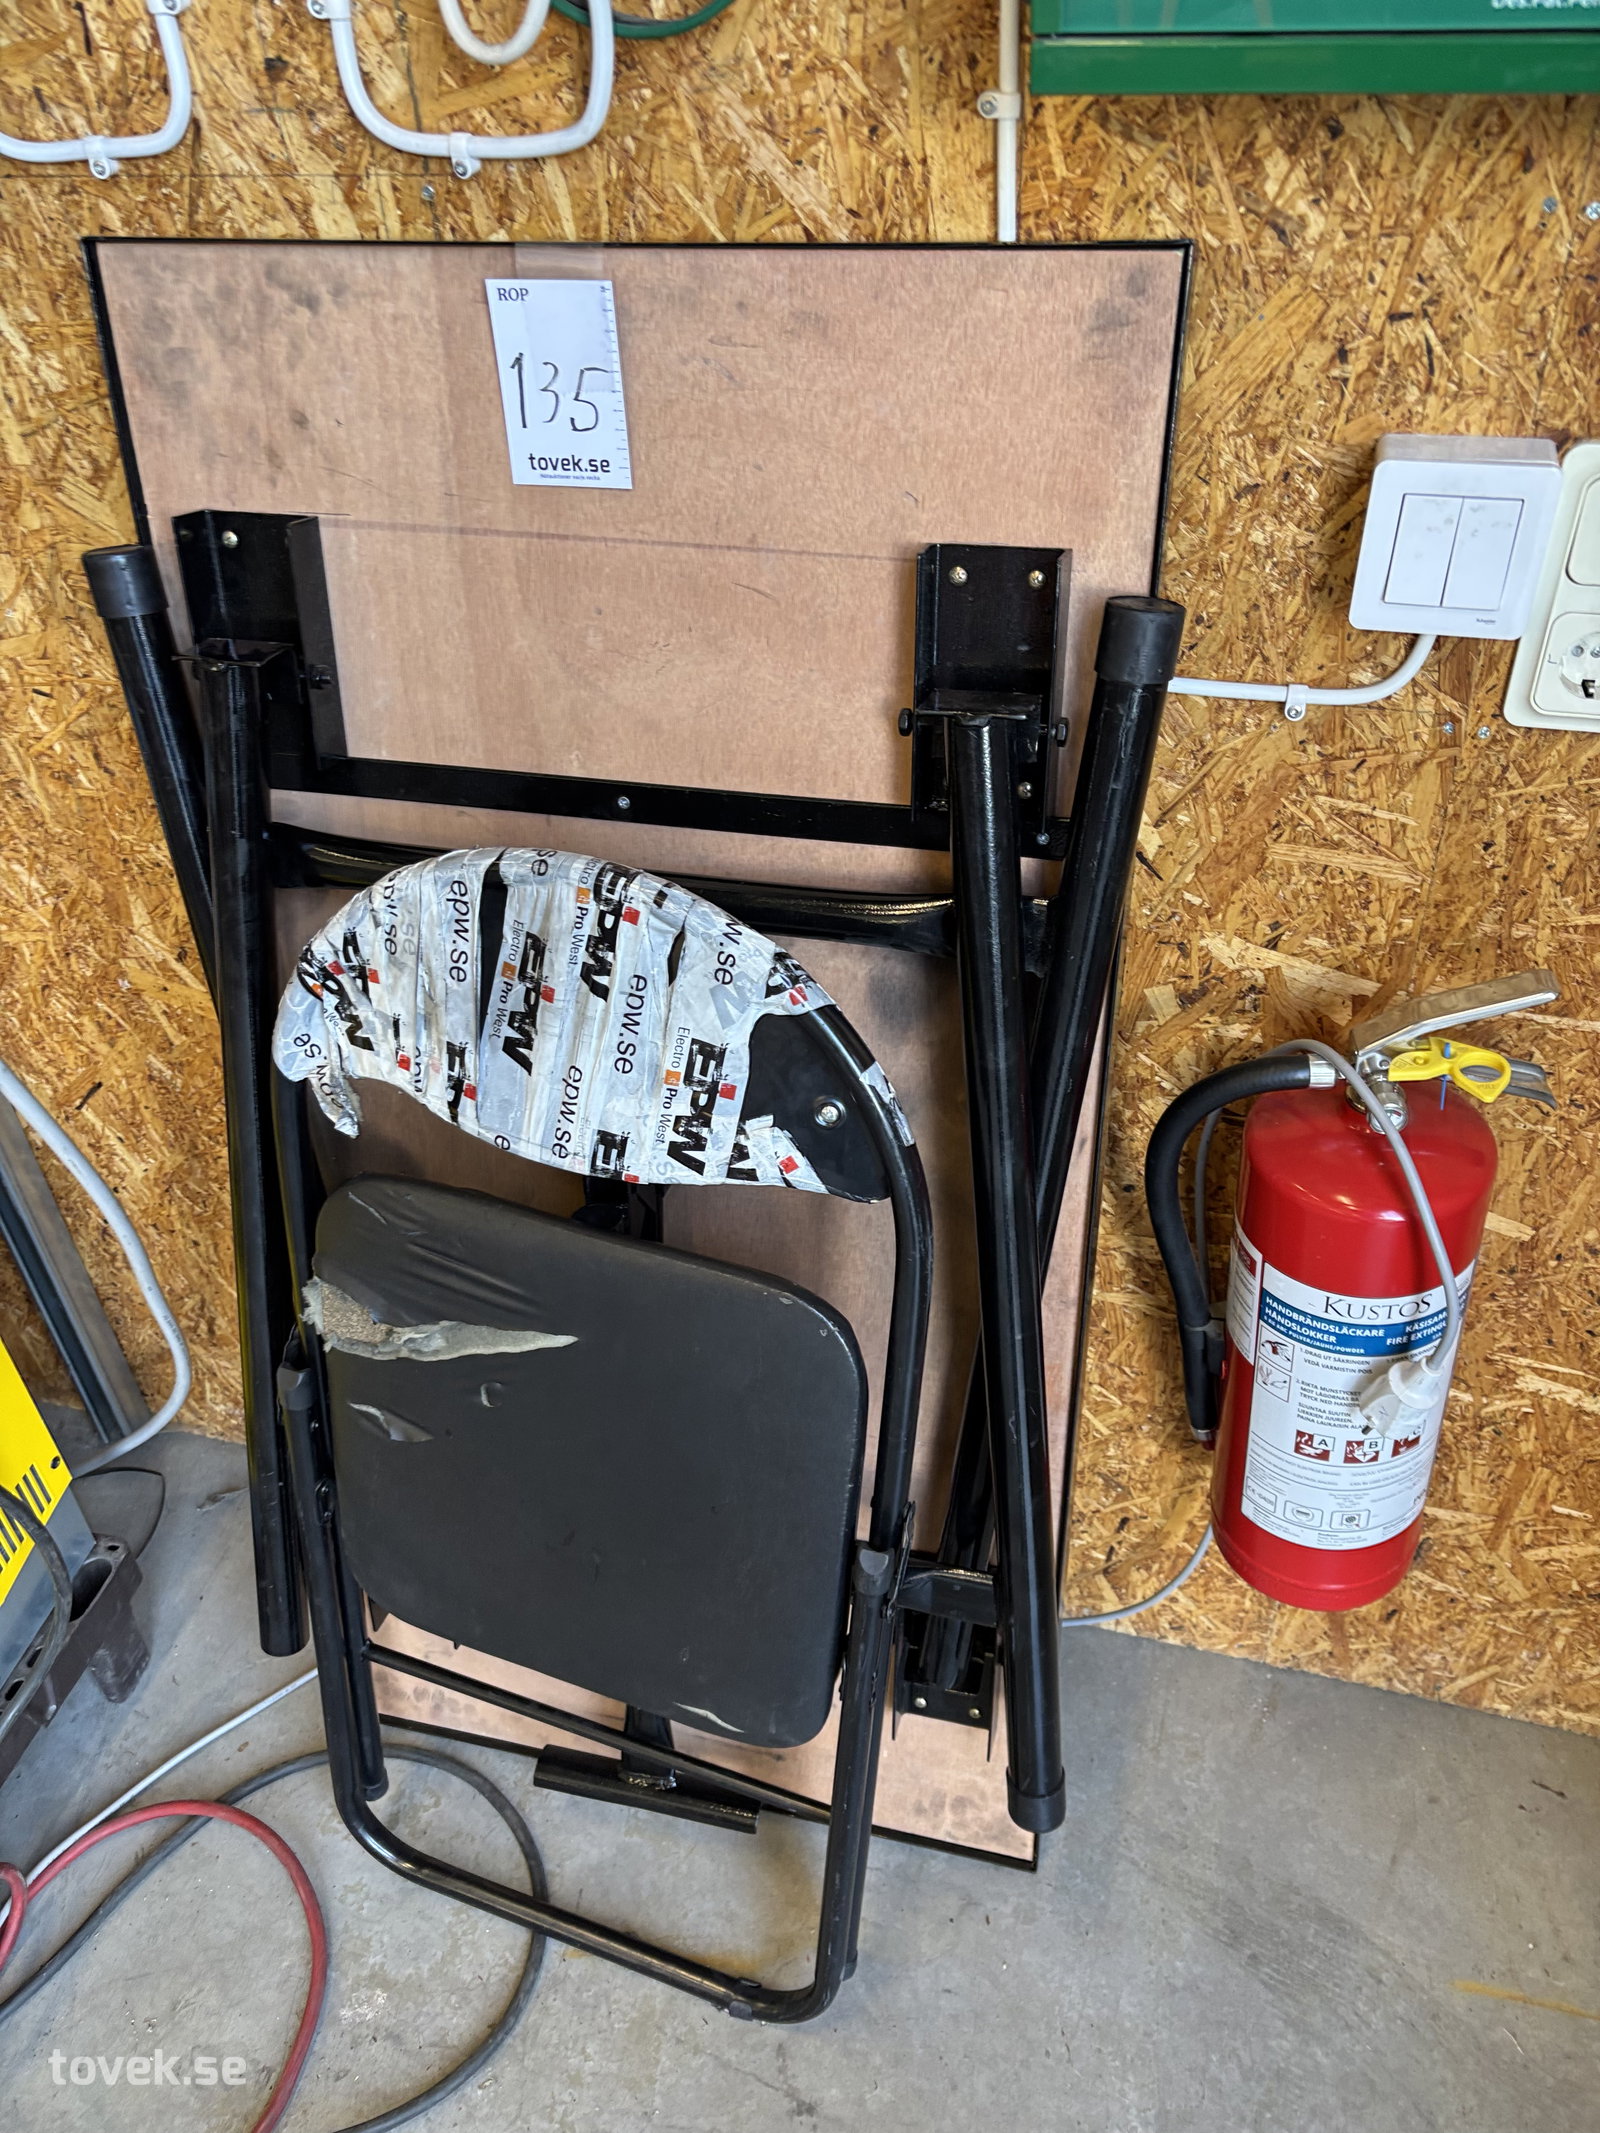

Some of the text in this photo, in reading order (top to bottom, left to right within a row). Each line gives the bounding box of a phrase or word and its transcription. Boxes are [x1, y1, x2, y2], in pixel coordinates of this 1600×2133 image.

[497, 287, 529, 301] ROP
[510, 353, 609, 432] 135
[528, 453, 611, 473] tovek.se
[446, 879, 470, 983] epw.se
[575, 905, 588, 930] Pro
[580, 862, 641, 1003] EPW
[489, 919, 524, 1039] Electro Pro West
[567, 934, 585, 966] West
[502, 931, 547, 1077] EPW
[614, 973, 648, 1075] epw.se
[551, 1065, 583, 1159] epw.se
[655, 1026, 691, 1145] Electro Pro West
[667, 1037, 727, 1176] EPW
[1266, 1296, 1385, 1337] HANDBRÄNDSLÄCKARE
[1319, 1293, 1434, 1321] KUSTOS
[1386, 1335, 1409, 1346] FIRE
[1317, 1438, 1329, 1448] A
[1369, 1441, 1379, 1450] B
